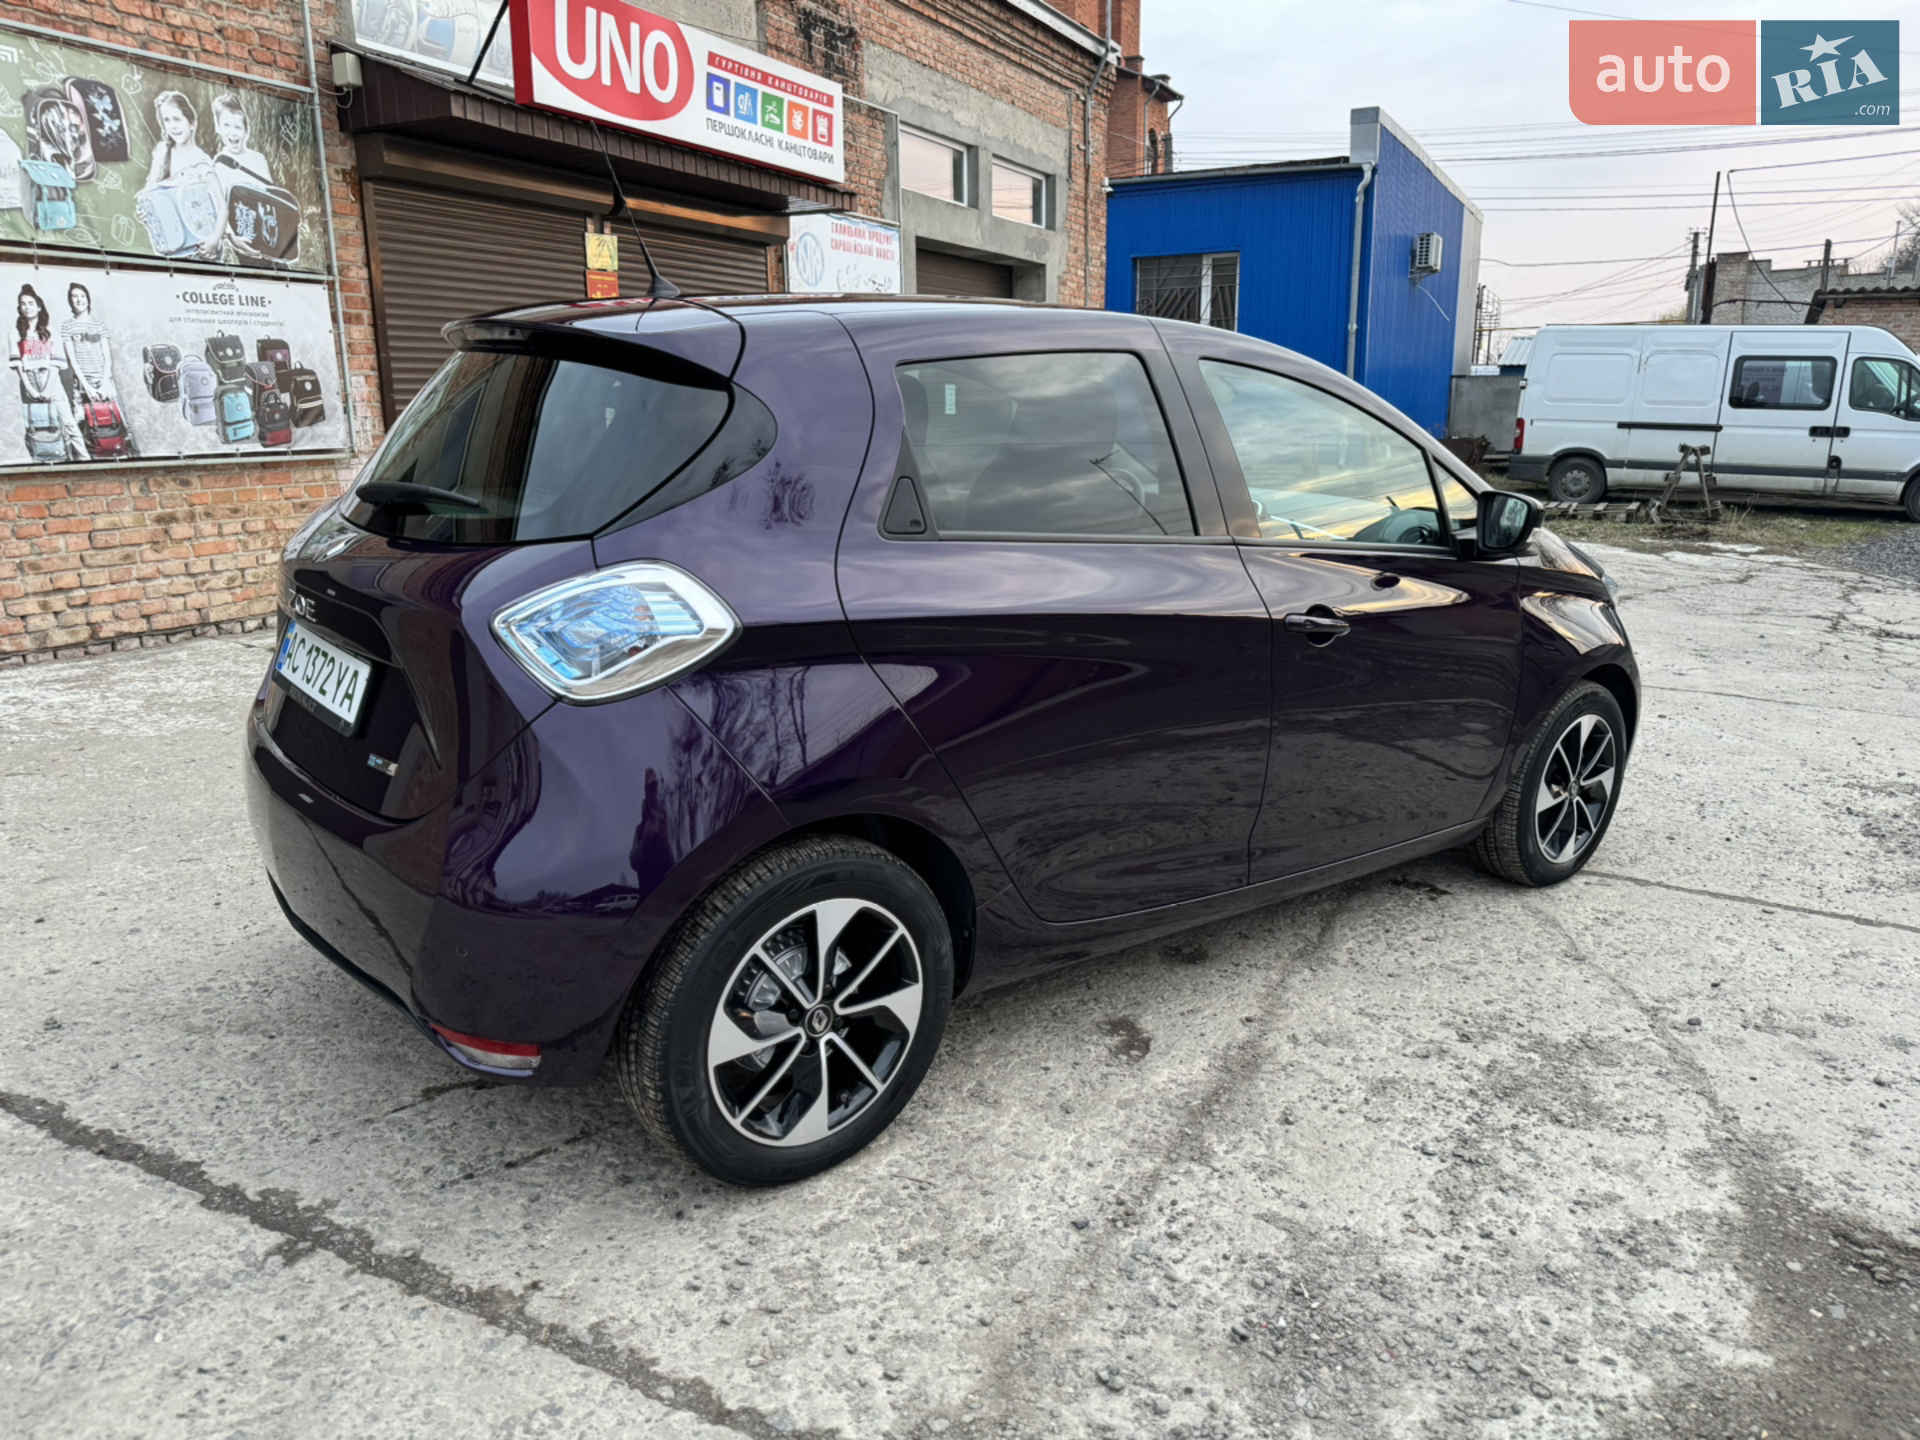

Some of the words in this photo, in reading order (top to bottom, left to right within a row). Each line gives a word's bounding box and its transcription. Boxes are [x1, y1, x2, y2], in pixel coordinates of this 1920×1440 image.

[555, 0, 679, 104] UNO
[767, 75, 828, 104] КАНЦТОВАРІВ
[706, 117, 774, 148] ПЕРШОКЛАСНІ
[777, 138, 835, 165] КАНЦТОВАРИ
[182, 291, 236, 306] COLLEGE
[238, 294, 267, 308] LINE
[288, 588, 318, 623] ZOE
[283, 631, 306, 675] AC
[301, 643, 336, 698] 1372
[331, 661, 360, 713] YA
